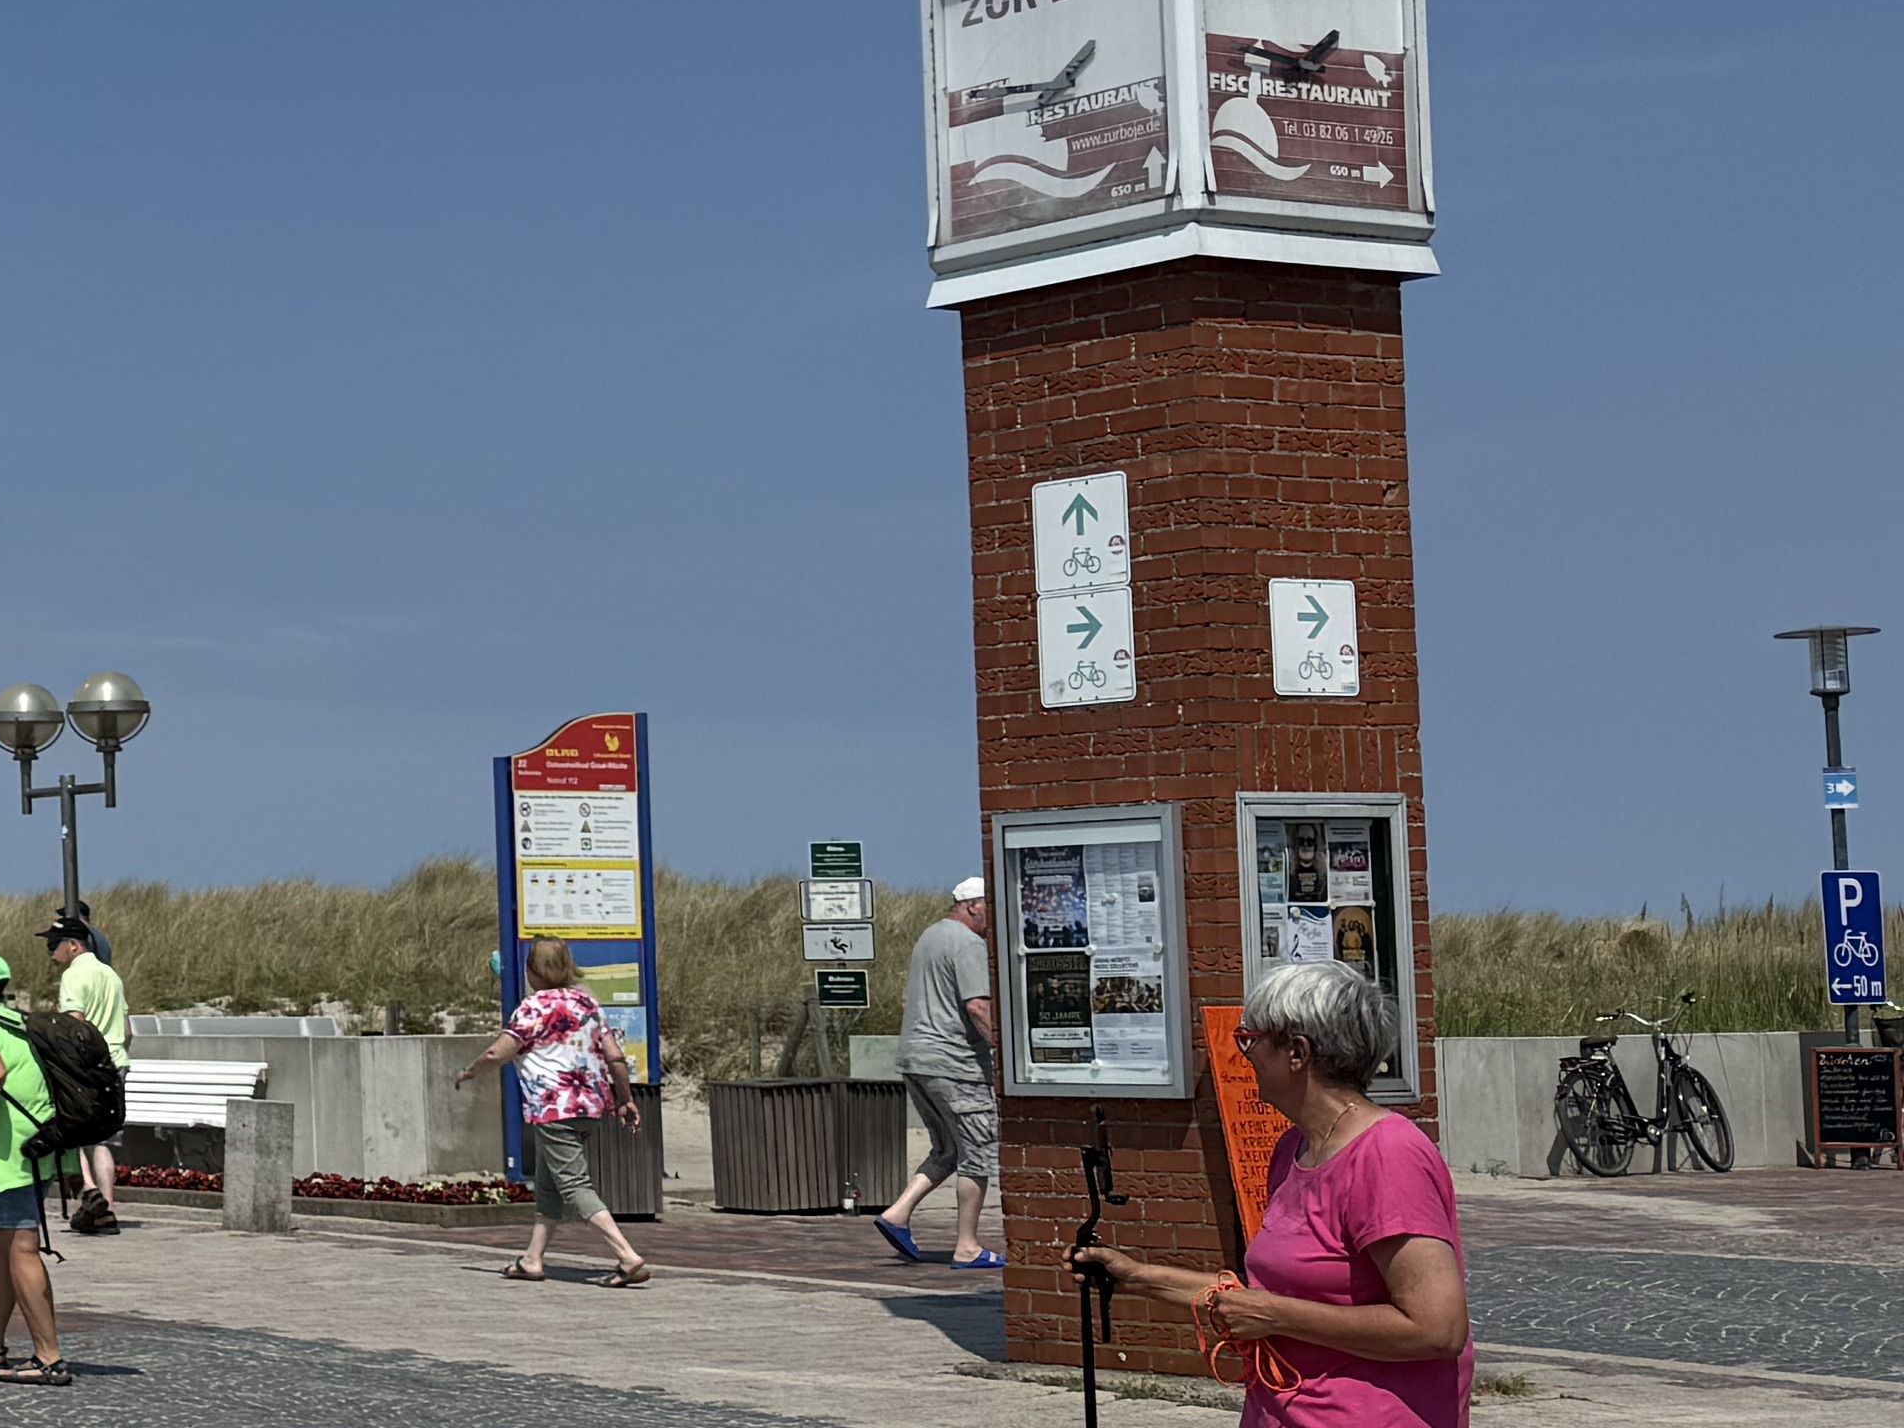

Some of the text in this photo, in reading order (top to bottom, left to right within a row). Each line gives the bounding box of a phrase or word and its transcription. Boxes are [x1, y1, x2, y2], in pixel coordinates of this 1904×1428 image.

[1209, 72, 1391, 107] FISCRESTAURANT
[1071, 120, 1161, 151] www.zurboje.de
[1319, 125, 1332, 139] 82
[1335, 126, 1348, 141] 06
[1330, 164, 1348, 176] 650
[1111, 185, 1132, 197] 650
[1838, 878, 1863, 926] P
[1853, 975, 1882, 997] 50 m
